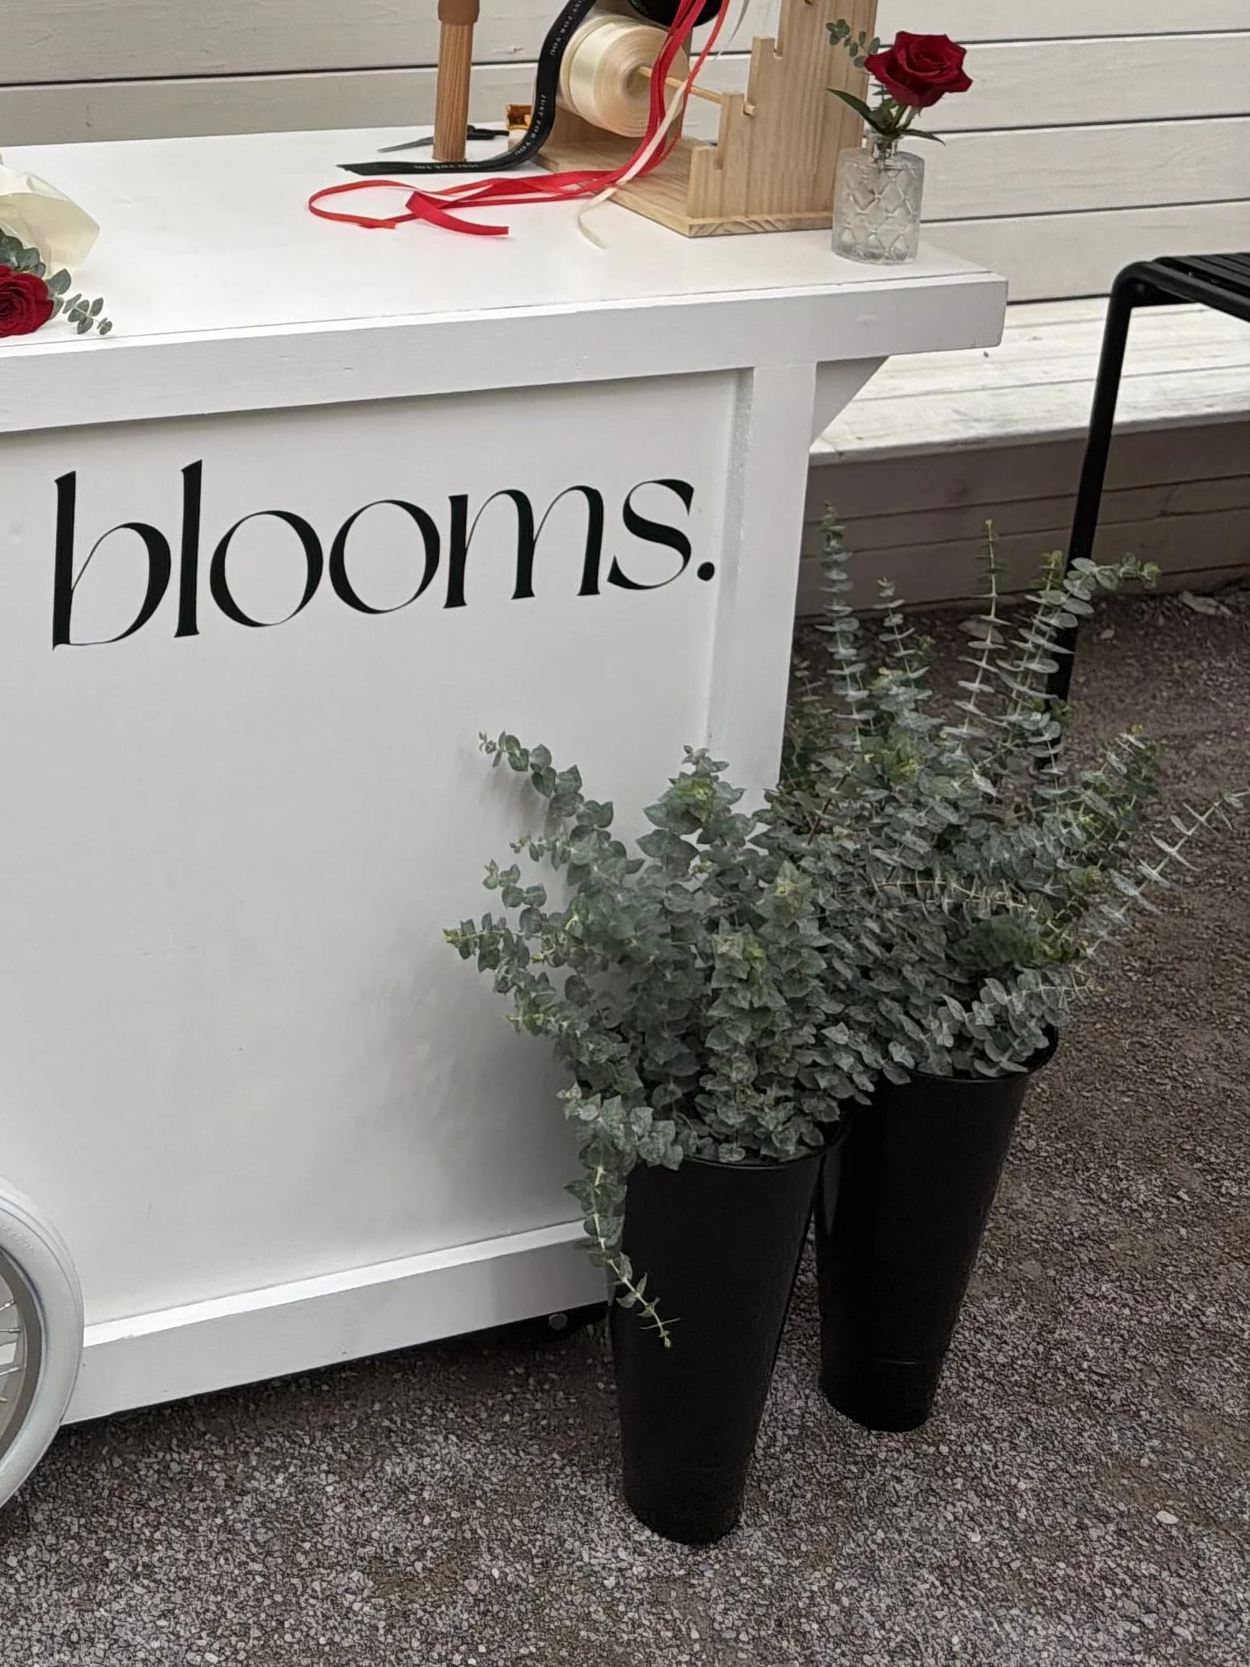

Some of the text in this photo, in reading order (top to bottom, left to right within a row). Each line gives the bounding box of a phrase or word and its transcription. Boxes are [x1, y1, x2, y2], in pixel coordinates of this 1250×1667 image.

[558, 15, 573, 34] FOR
[549, 36, 562, 56] YOU
[530, 119, 542, 139] FOR
[52, 459, 715, 651] blooms.
